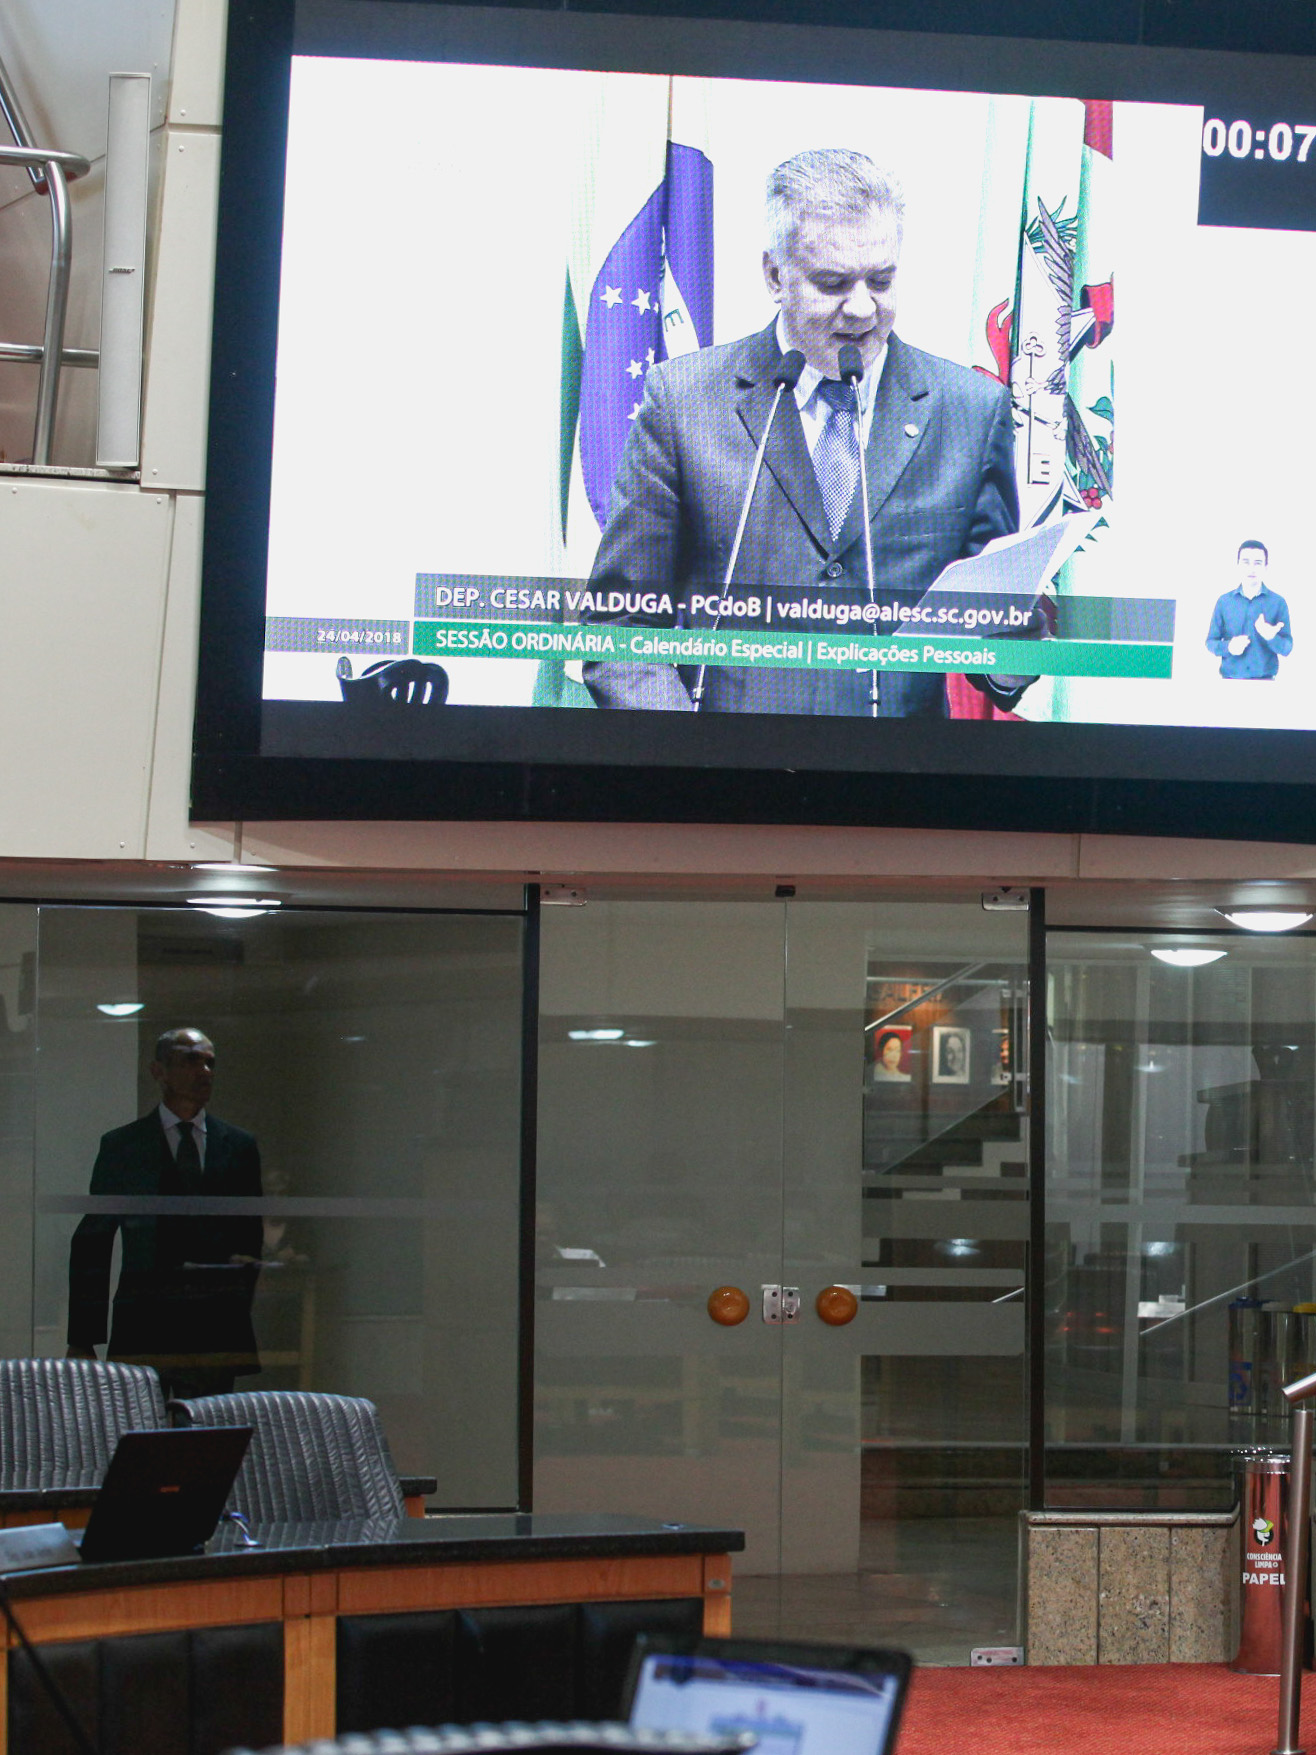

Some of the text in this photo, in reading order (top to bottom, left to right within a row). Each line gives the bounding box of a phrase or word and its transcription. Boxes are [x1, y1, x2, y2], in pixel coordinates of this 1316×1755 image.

[436, 586, 485, 608] DEP.
[490, 588, 560, 610] CESAR
[565, 590, 673, 614] VALDUGA
[690, 594, 761, 617] PCdoB
[777, 597, 1032, 629] valduga@alesc.sc.gov.br
[317, 629, 402, 643] 24/04/2018
[436, 629, 508, 650] SESSÃO
[511, 631, 615, 653] ORDINÁRIA
[630, 636, 728, 656] Calendário
[731, 638, 803, 662] Especial
[817, 641, 919, 665] Explicações
[923, 645, 996, 665] Pessoais
[1246, 1552, 1283, 1561] CONSCIÊNCIA
[1242, 1572, 1286, 1585] PAPEL
